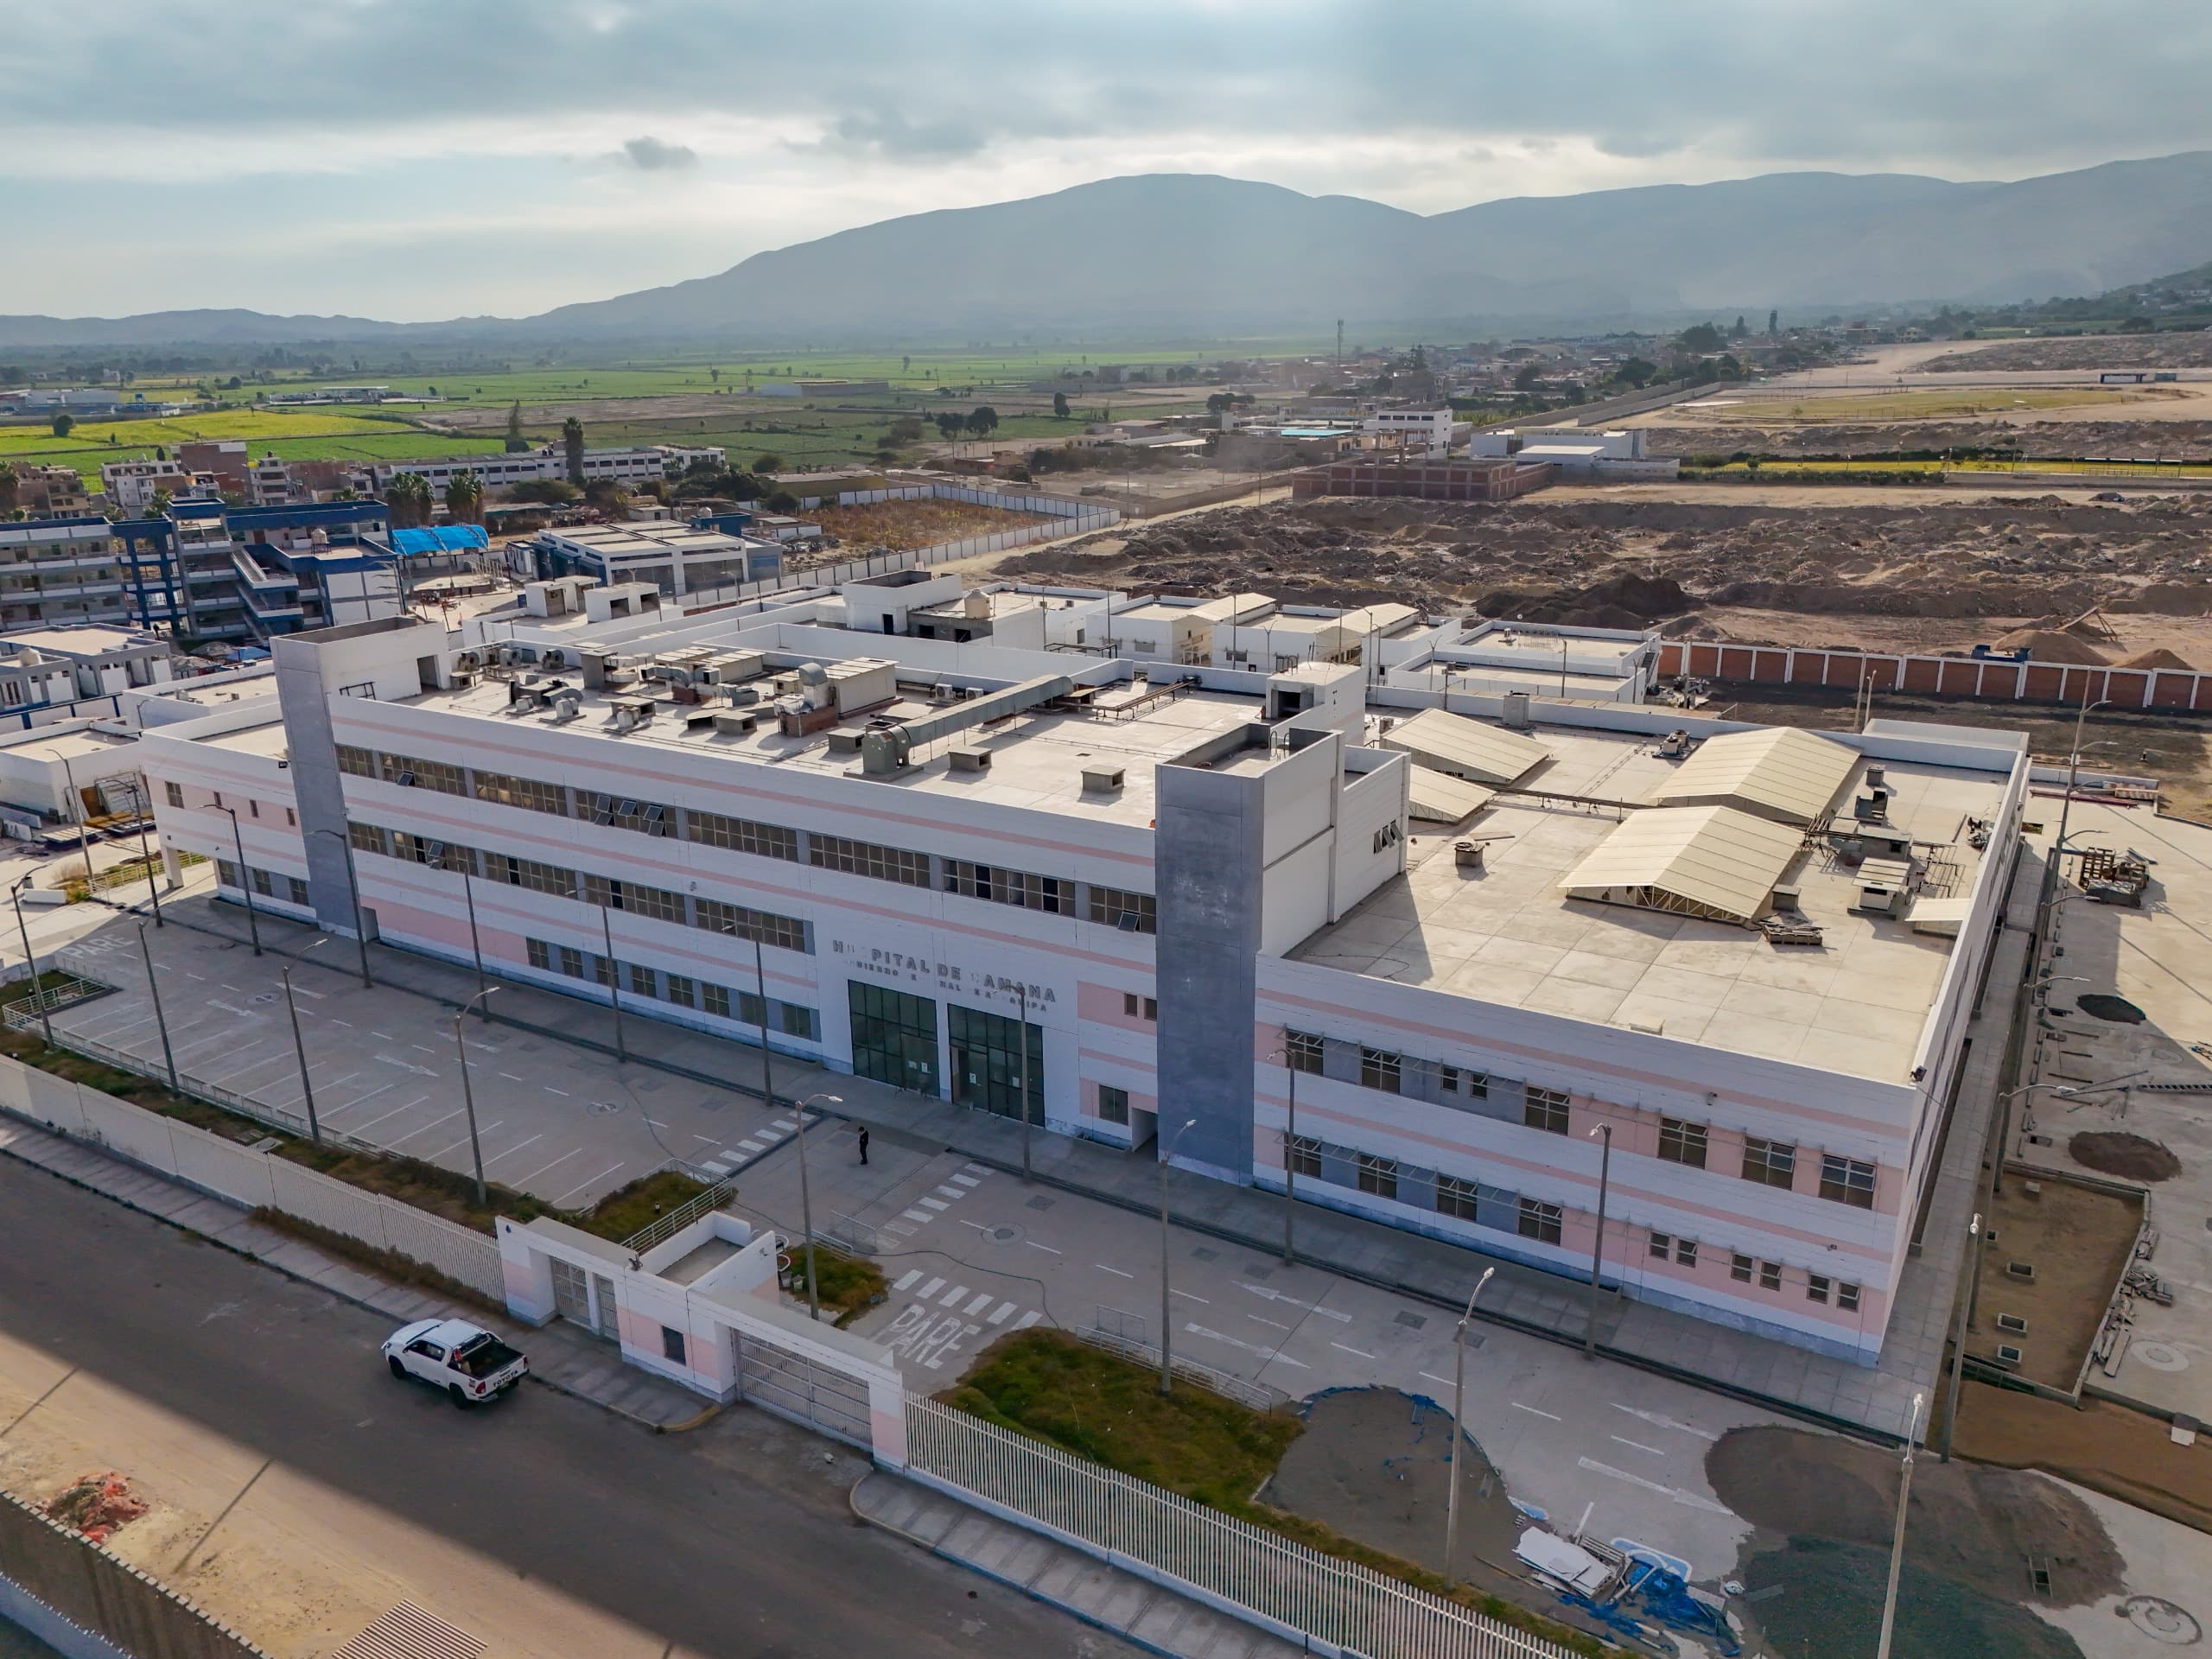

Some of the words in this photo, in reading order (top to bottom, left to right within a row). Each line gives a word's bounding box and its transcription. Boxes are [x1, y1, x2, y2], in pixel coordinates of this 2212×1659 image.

[59, 933, 137, 959] PARE
[832, 939, 930, 974] HPITAL
[937, 963, 961, 982] DE
[843, 960, 899, 976] BIERNO
[868, 1304, 982, 1370] PARE
[493, 1370, 518, 1388] TOYOTA
